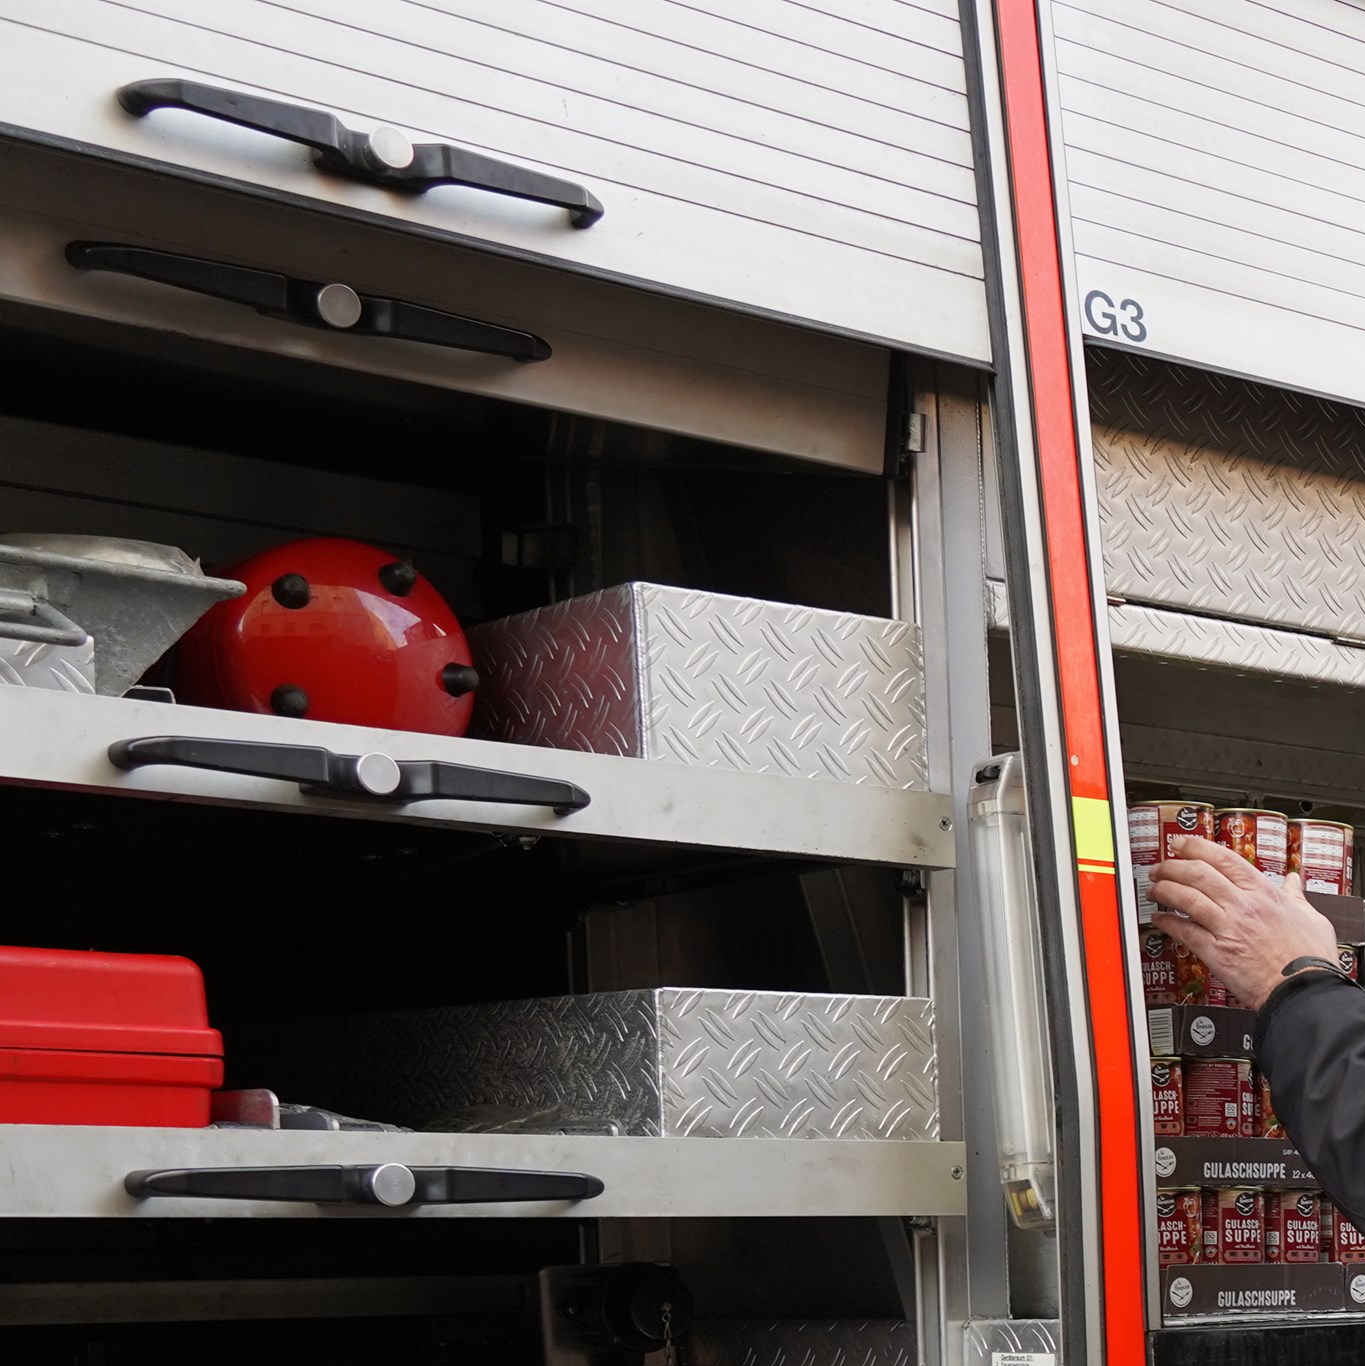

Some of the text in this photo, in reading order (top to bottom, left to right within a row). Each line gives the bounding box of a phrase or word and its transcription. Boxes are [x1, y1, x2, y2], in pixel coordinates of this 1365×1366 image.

[1084, 289, 1147, 342] G3
[1204, 1162, 1286, 1179] GULASCHSUPPE
[1225, 1219, 1261, 1230] GULASCH-
[1225, 1230, 1261, 1242] SUPPE
[1287, 1230, 1320, 1244] SUPPE
[1218, 1290, 1296, 1307] GULASCHSUPPE
